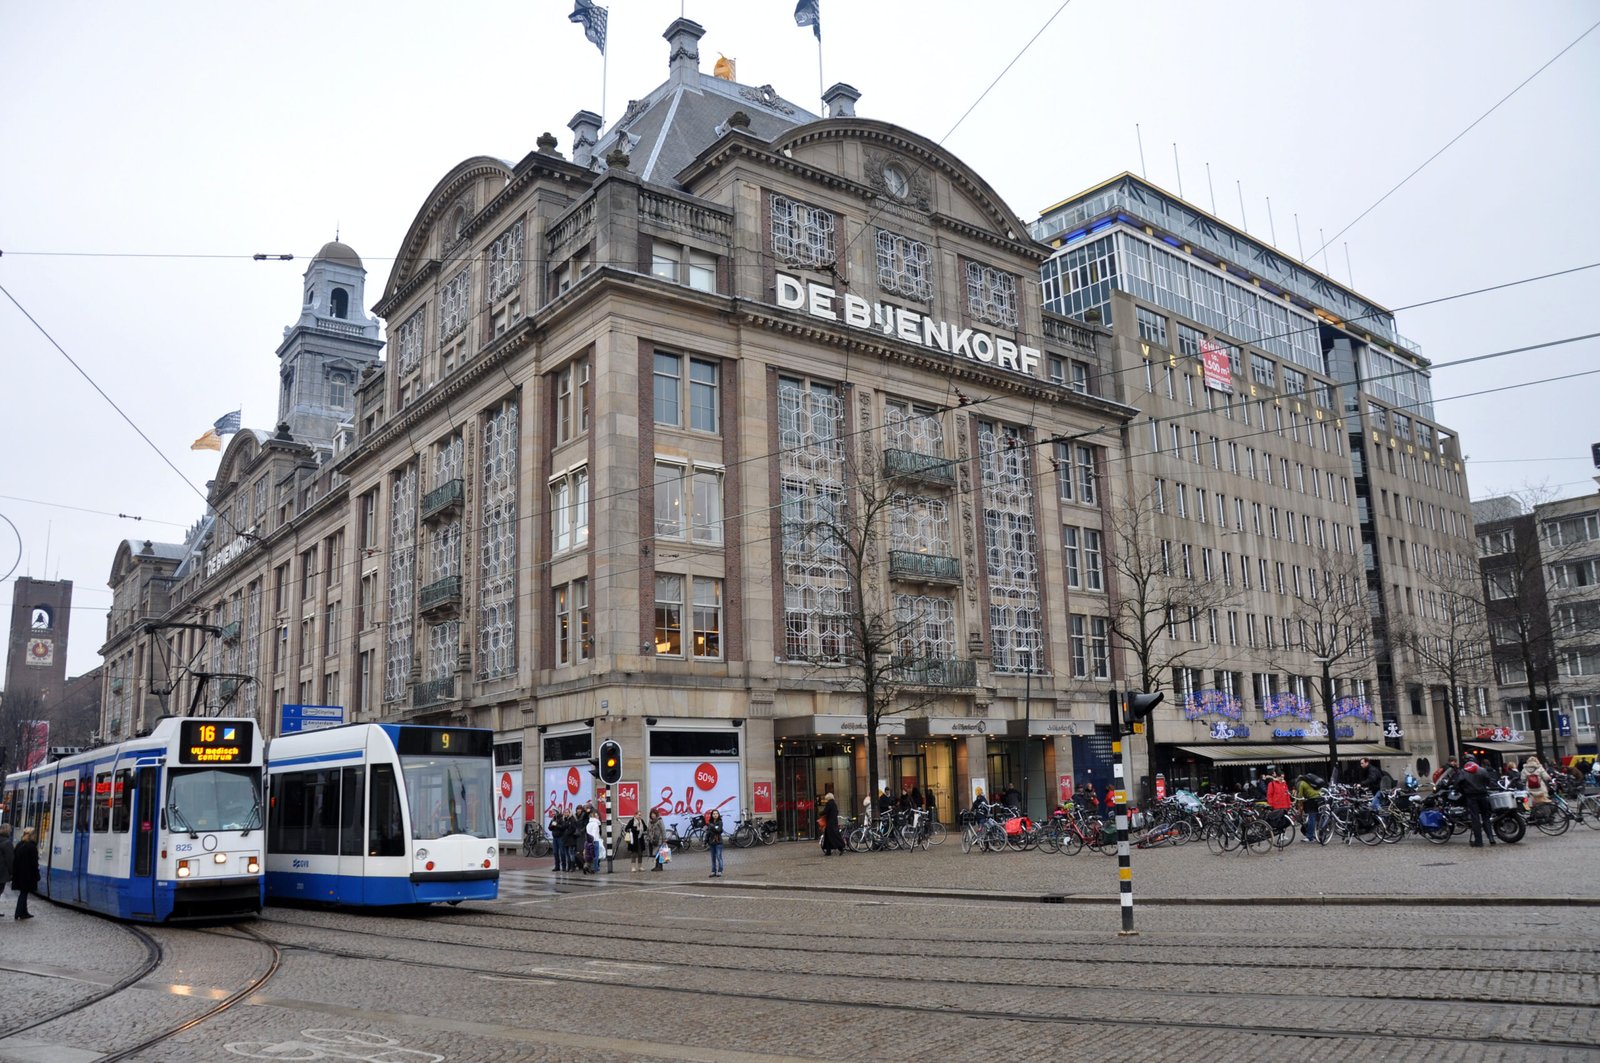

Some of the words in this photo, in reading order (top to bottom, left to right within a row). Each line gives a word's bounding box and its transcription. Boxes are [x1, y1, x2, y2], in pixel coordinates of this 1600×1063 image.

[776, 273, 837, 321] DE
[844, 292, 1041, 376] BIJENKORF
[199, 725, 216, 742] 16
[442, 733, 450, 749] 9
[191, 747, 204, 755] VU
[205, 747, 239, 755] medisch
[567, 775, 578, 788] 50%
[698, 771, 715, 784] 50%
[652, 786, 704, 816] Sale
[176, 844, 193, 852] 825
